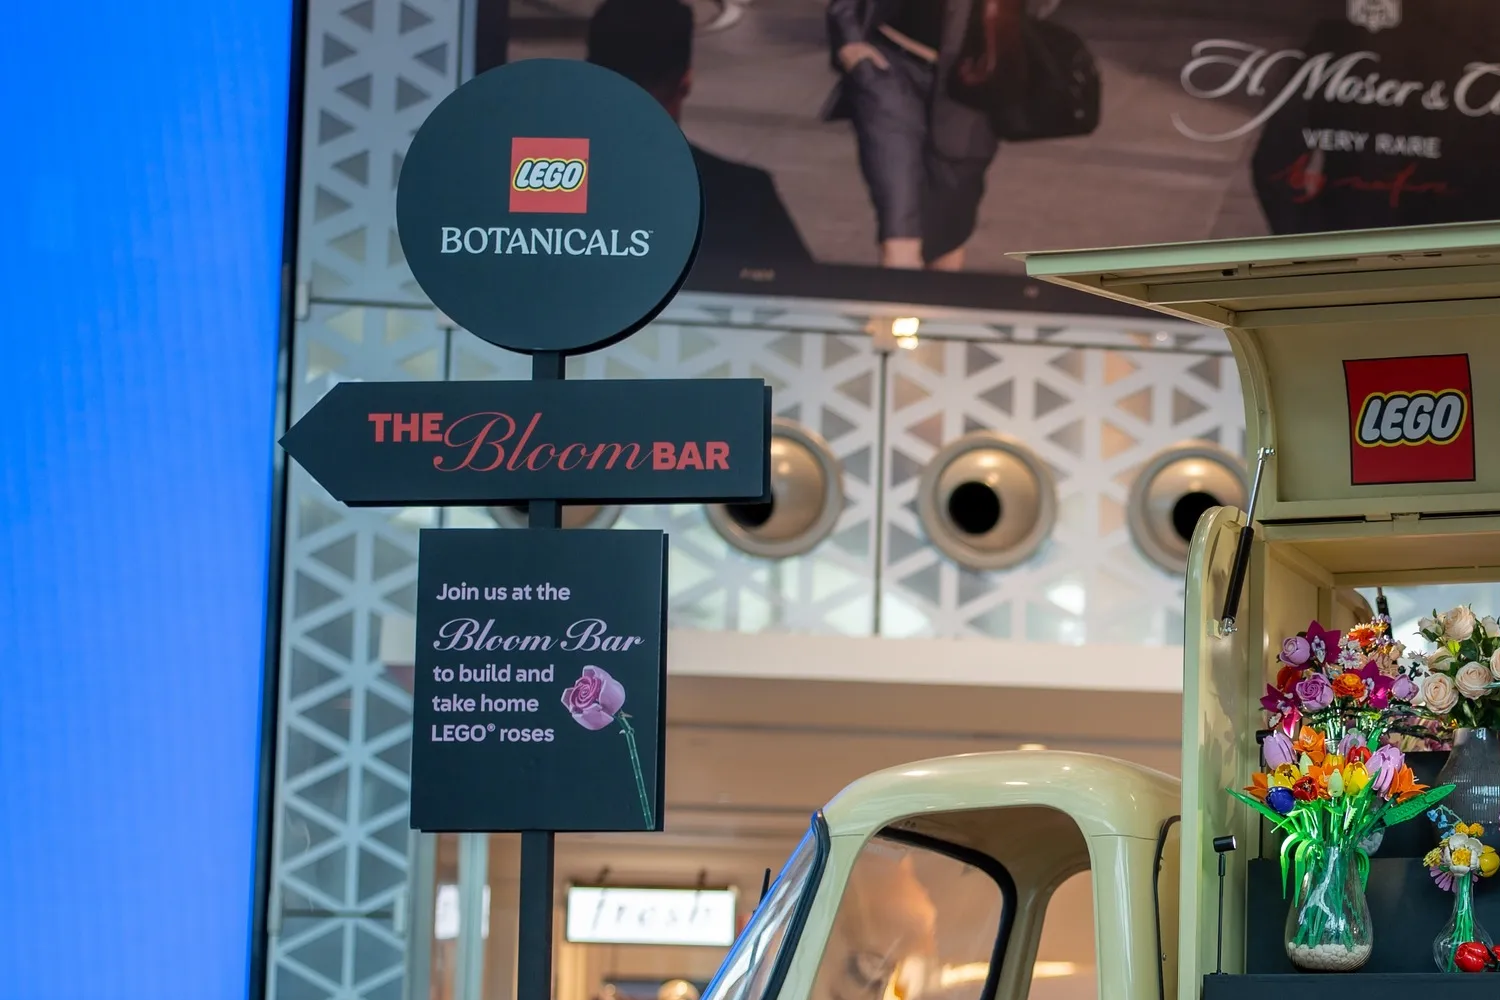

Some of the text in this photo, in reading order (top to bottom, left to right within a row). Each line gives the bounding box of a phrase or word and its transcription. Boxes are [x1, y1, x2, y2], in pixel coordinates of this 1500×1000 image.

[1421, 80, 1450, 111] &
[1303, 128, 1442, 159] VERY RARE
[513, 158, 586, 191] LEGO
[1355, 388, 1467, 448] LEGO
[368, 411, 730, 472] THE Bloom BAR
[436, 582, 571, 601] Join us at the
[433, 617, 645, 651] Bloom Bar
[433, 664, 554, 682] to build and
[432, 694, 539, 712] take home
[500, 726, 554, 742] roses
